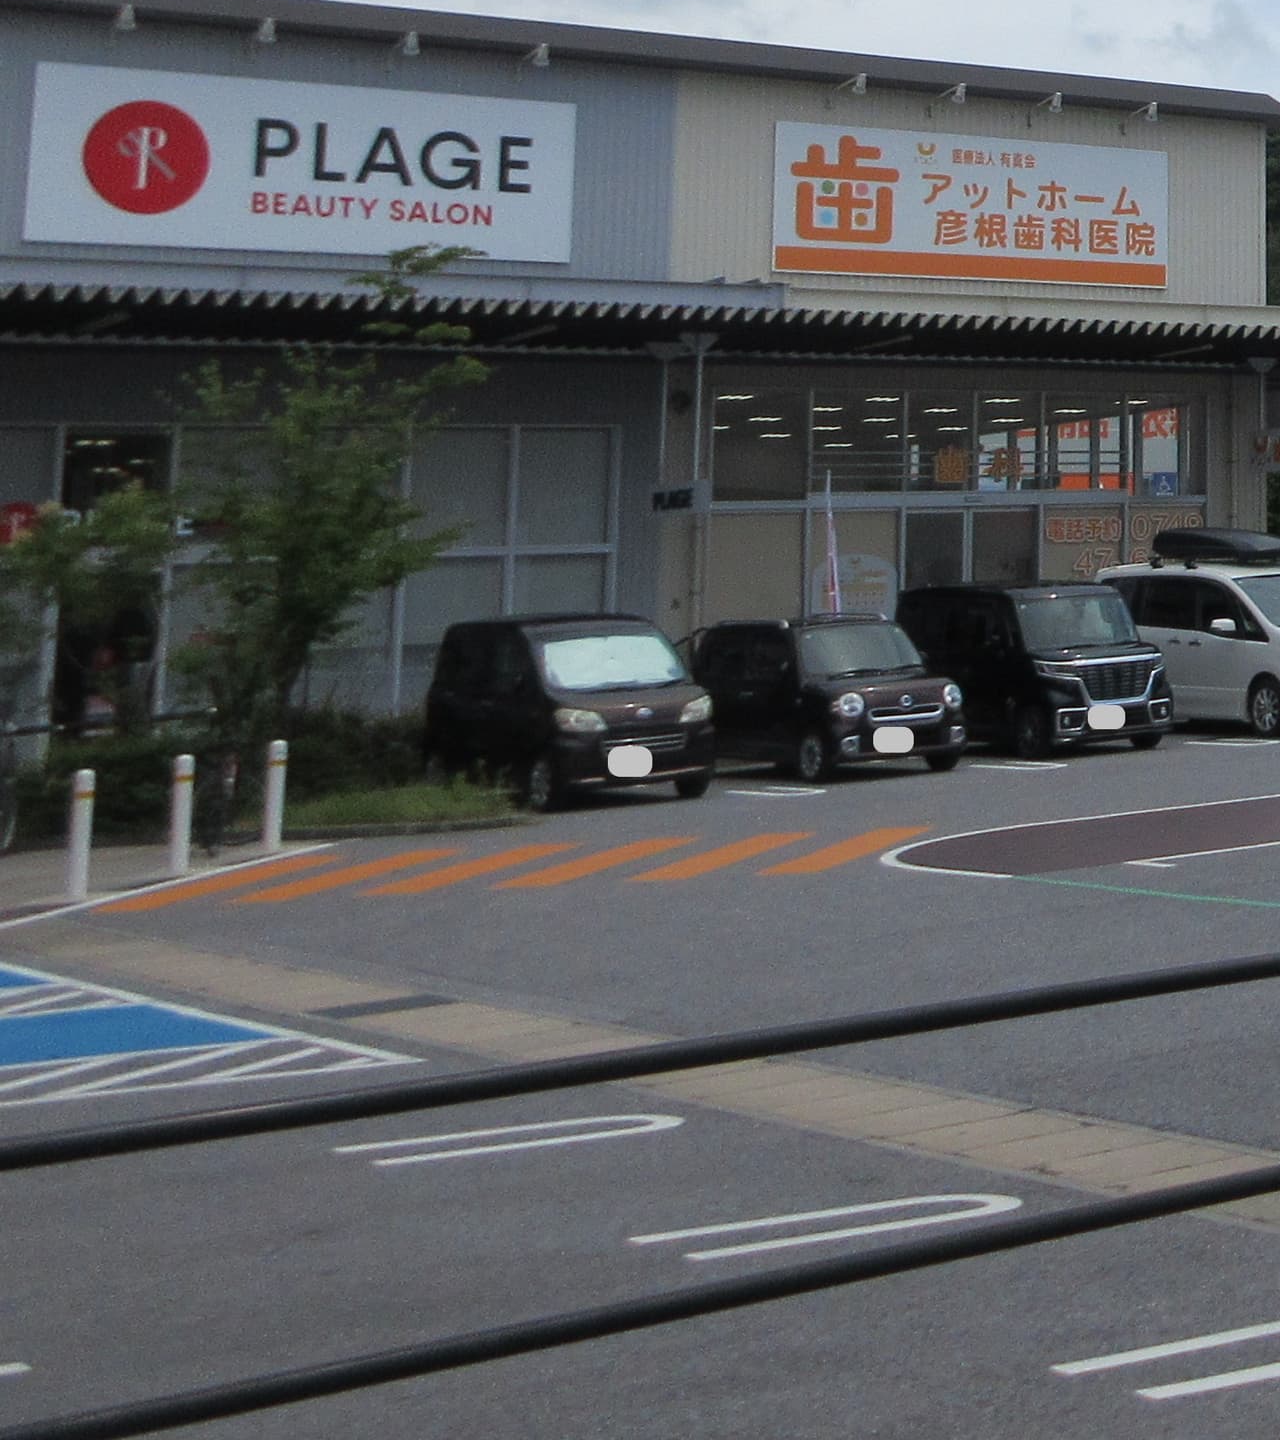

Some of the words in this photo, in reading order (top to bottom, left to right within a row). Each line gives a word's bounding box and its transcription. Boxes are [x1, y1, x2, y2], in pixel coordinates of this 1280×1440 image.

[254, 117, 534, 194] PLAGE
[250, 190, 378, 222] BEAUTY
[389, 198, 494, 228] SALON
[921, 172, 1142, 218] アットホーム
[933, 210, 1156, 258] 彦根歯科医院
